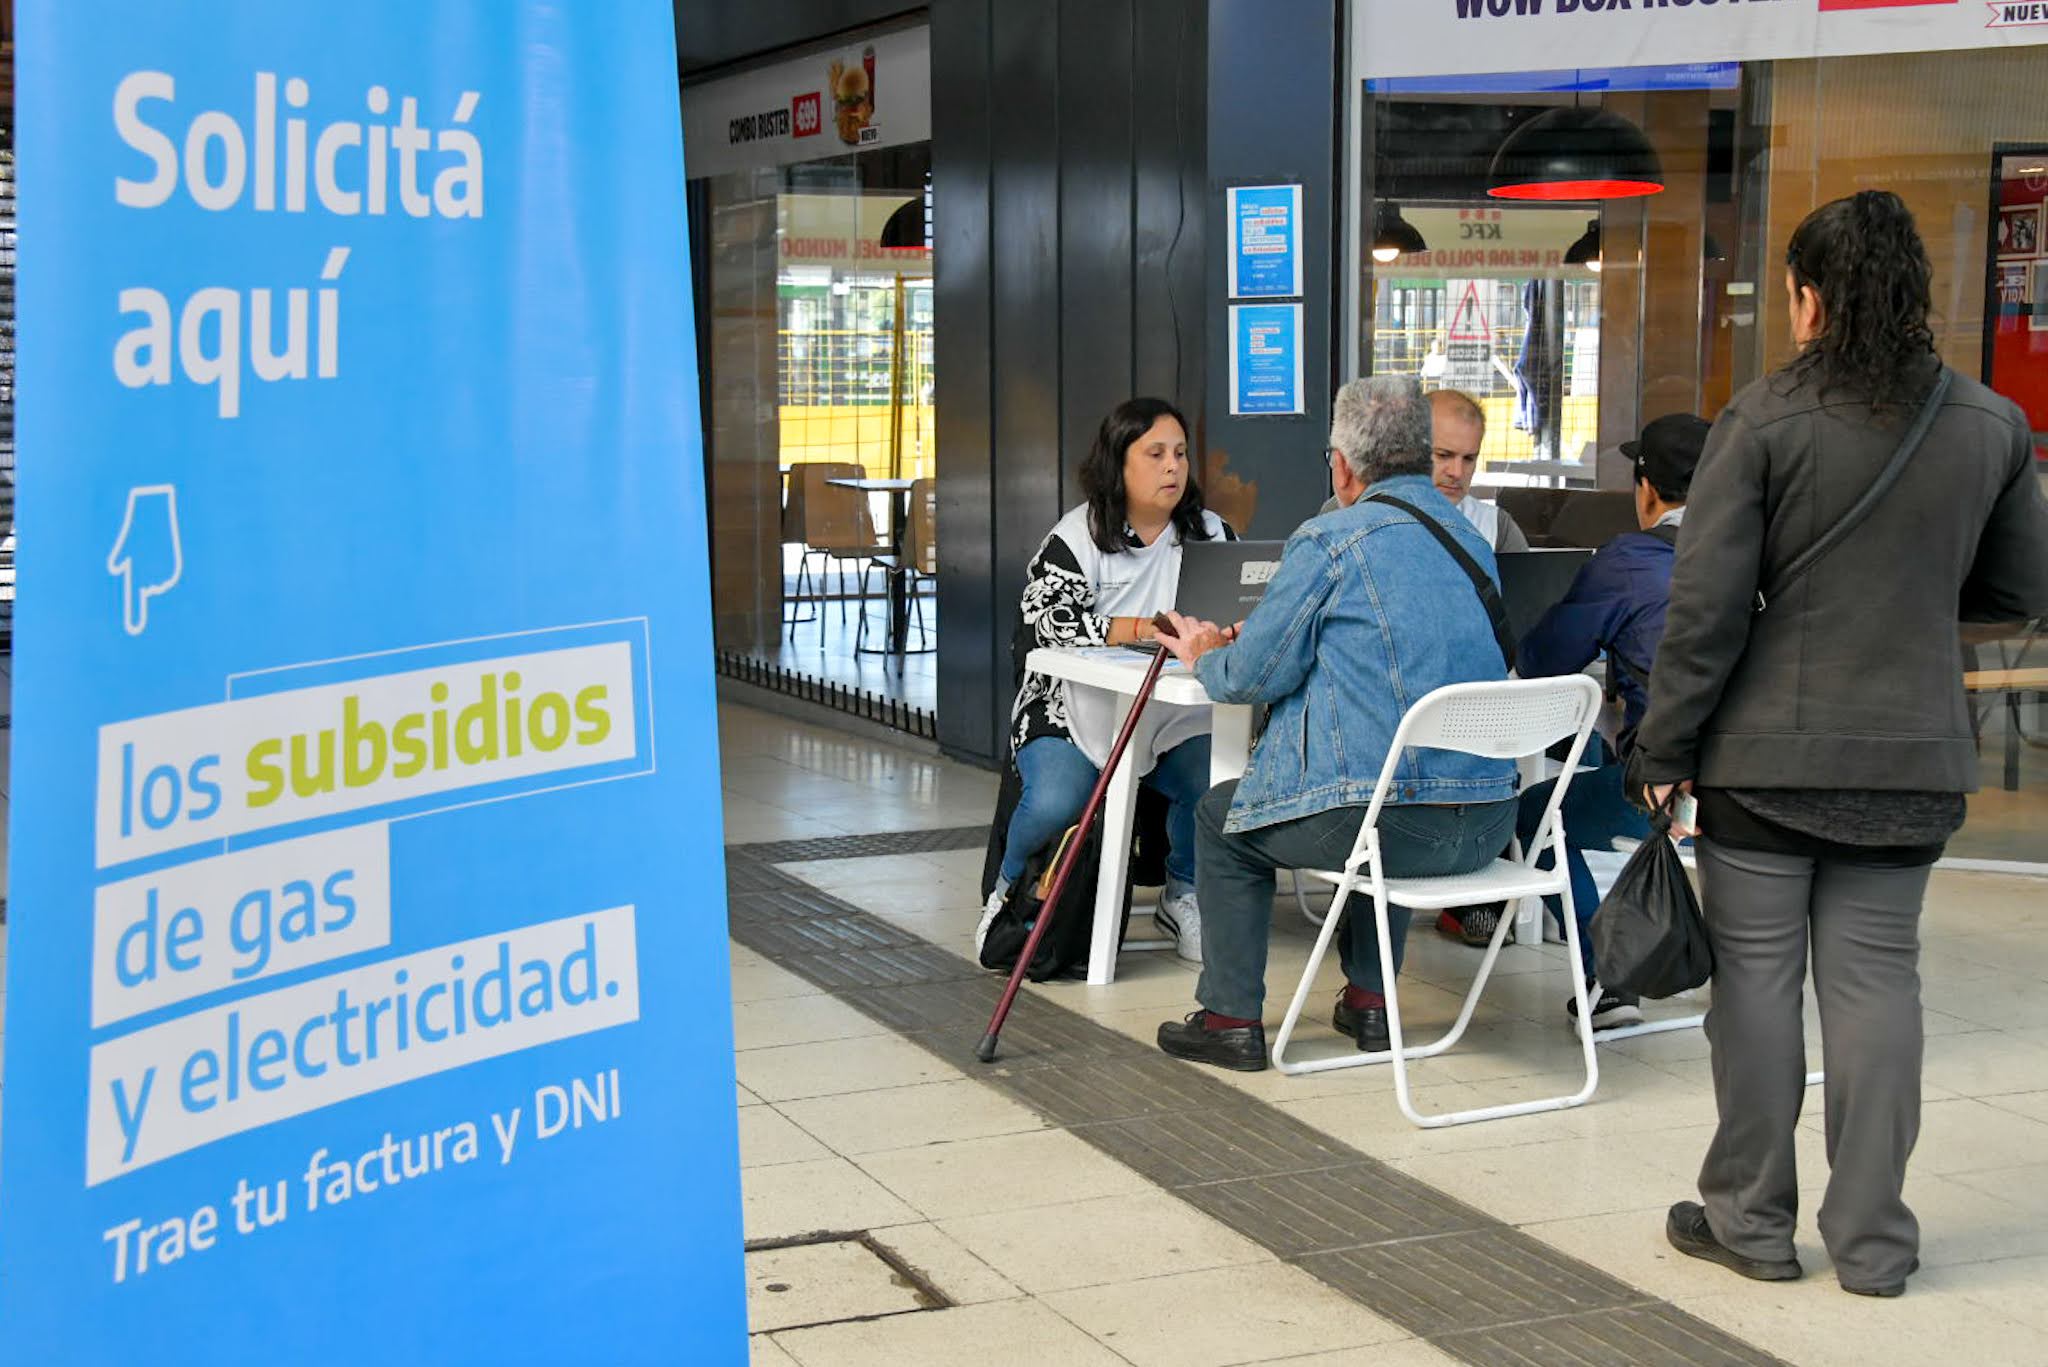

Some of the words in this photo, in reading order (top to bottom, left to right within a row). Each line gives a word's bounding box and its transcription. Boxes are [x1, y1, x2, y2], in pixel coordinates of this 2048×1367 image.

[113, 70, 484, 219] Solicitá
[730, 114, 757, 145] COMBO
[114, 246, 351, 418] aquí
[120, 742, 222, 838] los
[245, 671, 612, 808] subsidios
[115, 887, 205, 988] de
[229, 868, 357, 980] gas
[110, 1066, 158, 1165] y
[180, 922, 619, 1115] electricidad.
[104, 1204, 217, 1282] Trae
[232, 1180, 288, 1234] tu
[303, 1121, 478, 1211] factura
[491, 1108, 521, 1164] y
[535, 1068, 621, 1139] DNI
